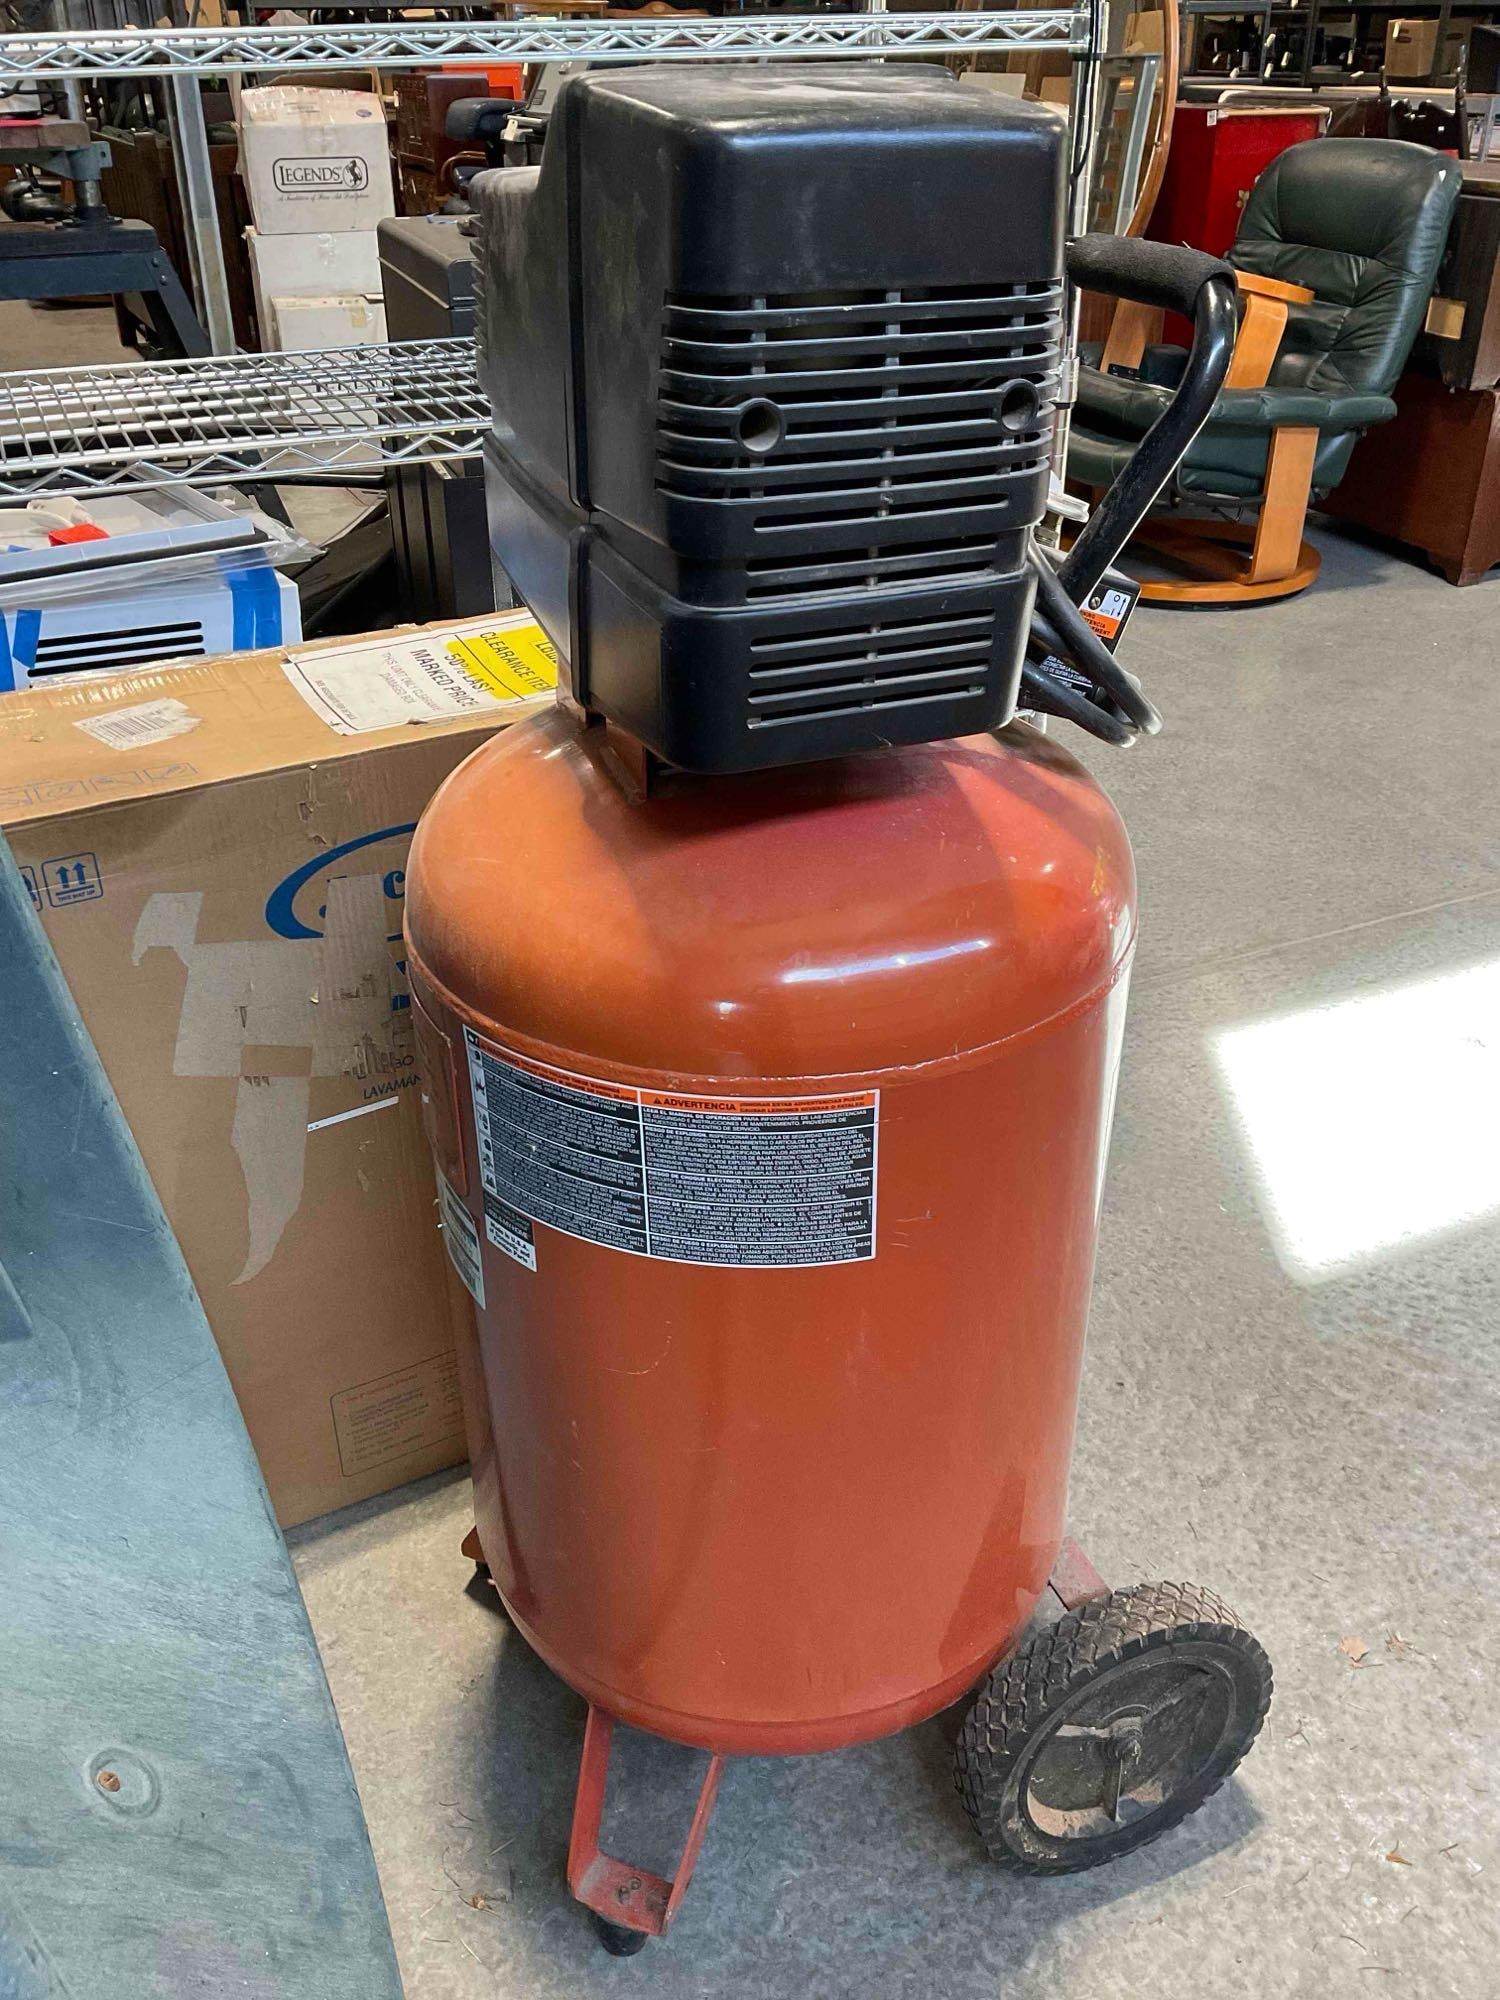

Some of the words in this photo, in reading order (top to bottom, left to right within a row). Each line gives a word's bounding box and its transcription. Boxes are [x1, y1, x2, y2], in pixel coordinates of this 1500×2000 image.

[279, 166, 341, 186] LEGENDS
[411, 649, 454, 686] MARKED
[444, 653, 471, 675] 50%
[462, 673, 495, 693] LAST
[480, 631, 536, 678] CLEARANCE
[663, 1097, 736, 1111] ADVERTENCIA
